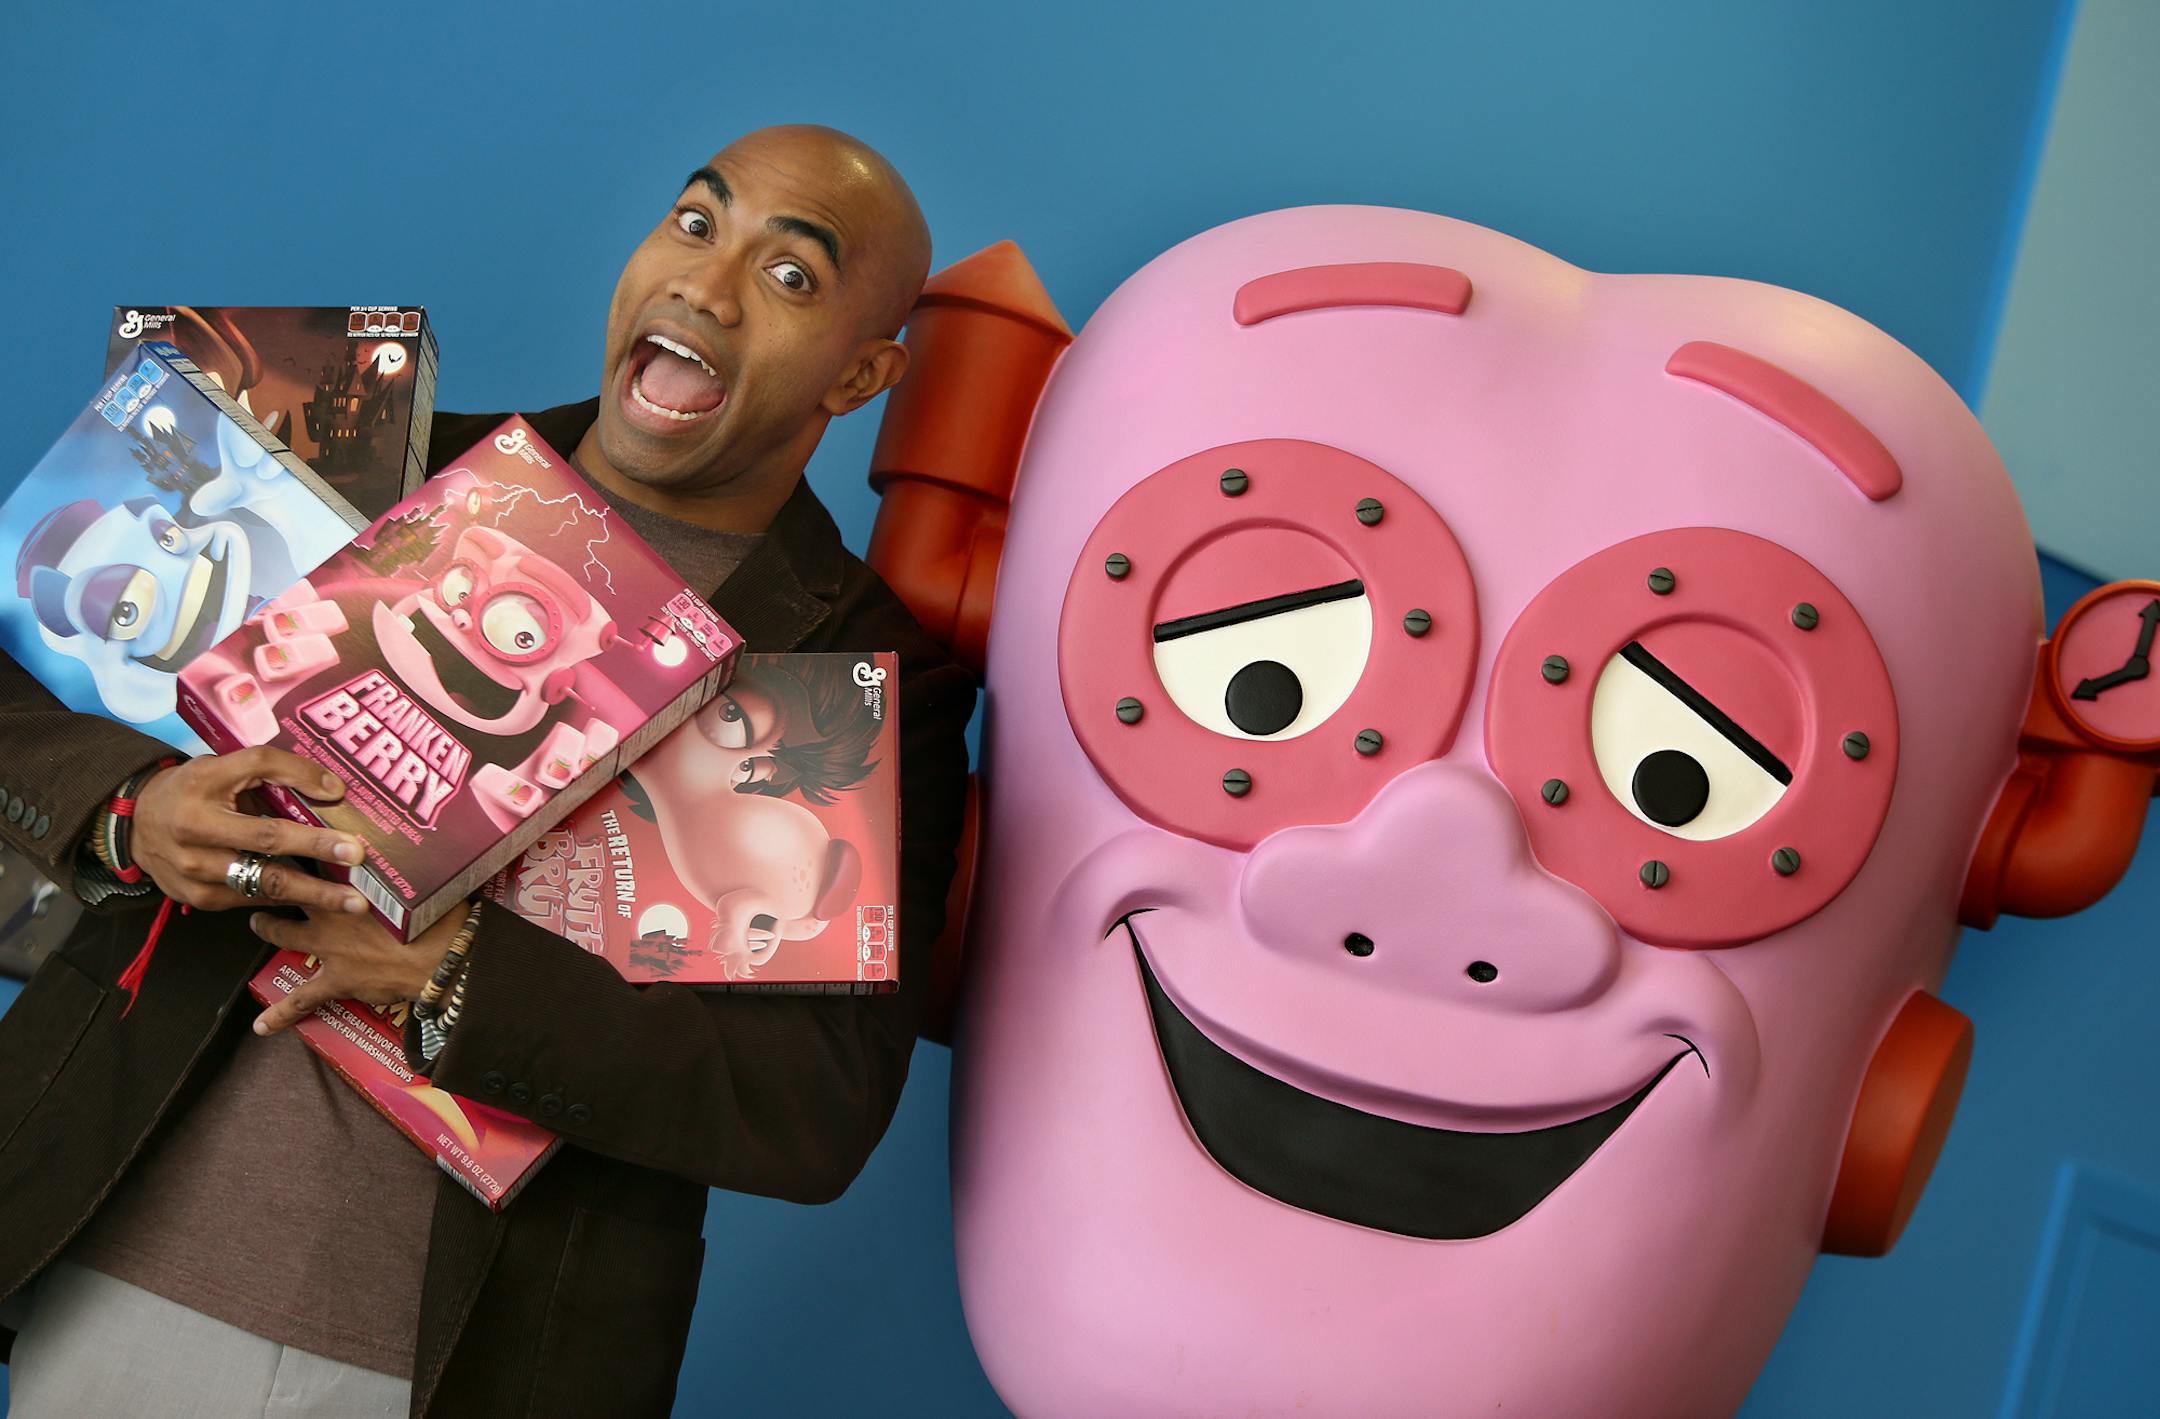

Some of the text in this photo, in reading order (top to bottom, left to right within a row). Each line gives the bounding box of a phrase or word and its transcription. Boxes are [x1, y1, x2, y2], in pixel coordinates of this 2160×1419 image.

[144, 314, 176, 322] General
[518, 448, 536, 464] Mills
[523, 444, 552, 469] General
[864, 688, 872, 706] Mills
[873, 687, 882, 720] General
[345, 671, 470, 786] FRANKEN
[280, 716, 316, 748] ARTIFICIAL
[312, 745, 354, 784] STRAWBERRY
[350, 779, 377, 804] FLAVOR
[372, 798, 402, 826] FROSTED
[399, 822, 424, 846] CEREAL
[302, 689, 455, 822] BERRY
[601, 810, 636, 919] THE RETURN OF
[315, 1008, 360, 1042] SPOOKY-FUN
[355, 1036, 415, 1083] MARSHMALLOWS
[342, 1011, 369, 1032] CREAM
[364, 1026, 395, 1051] FLAVOR
[437, 1133, 503, 1196] NET WT 9.6 OZ (272g)
